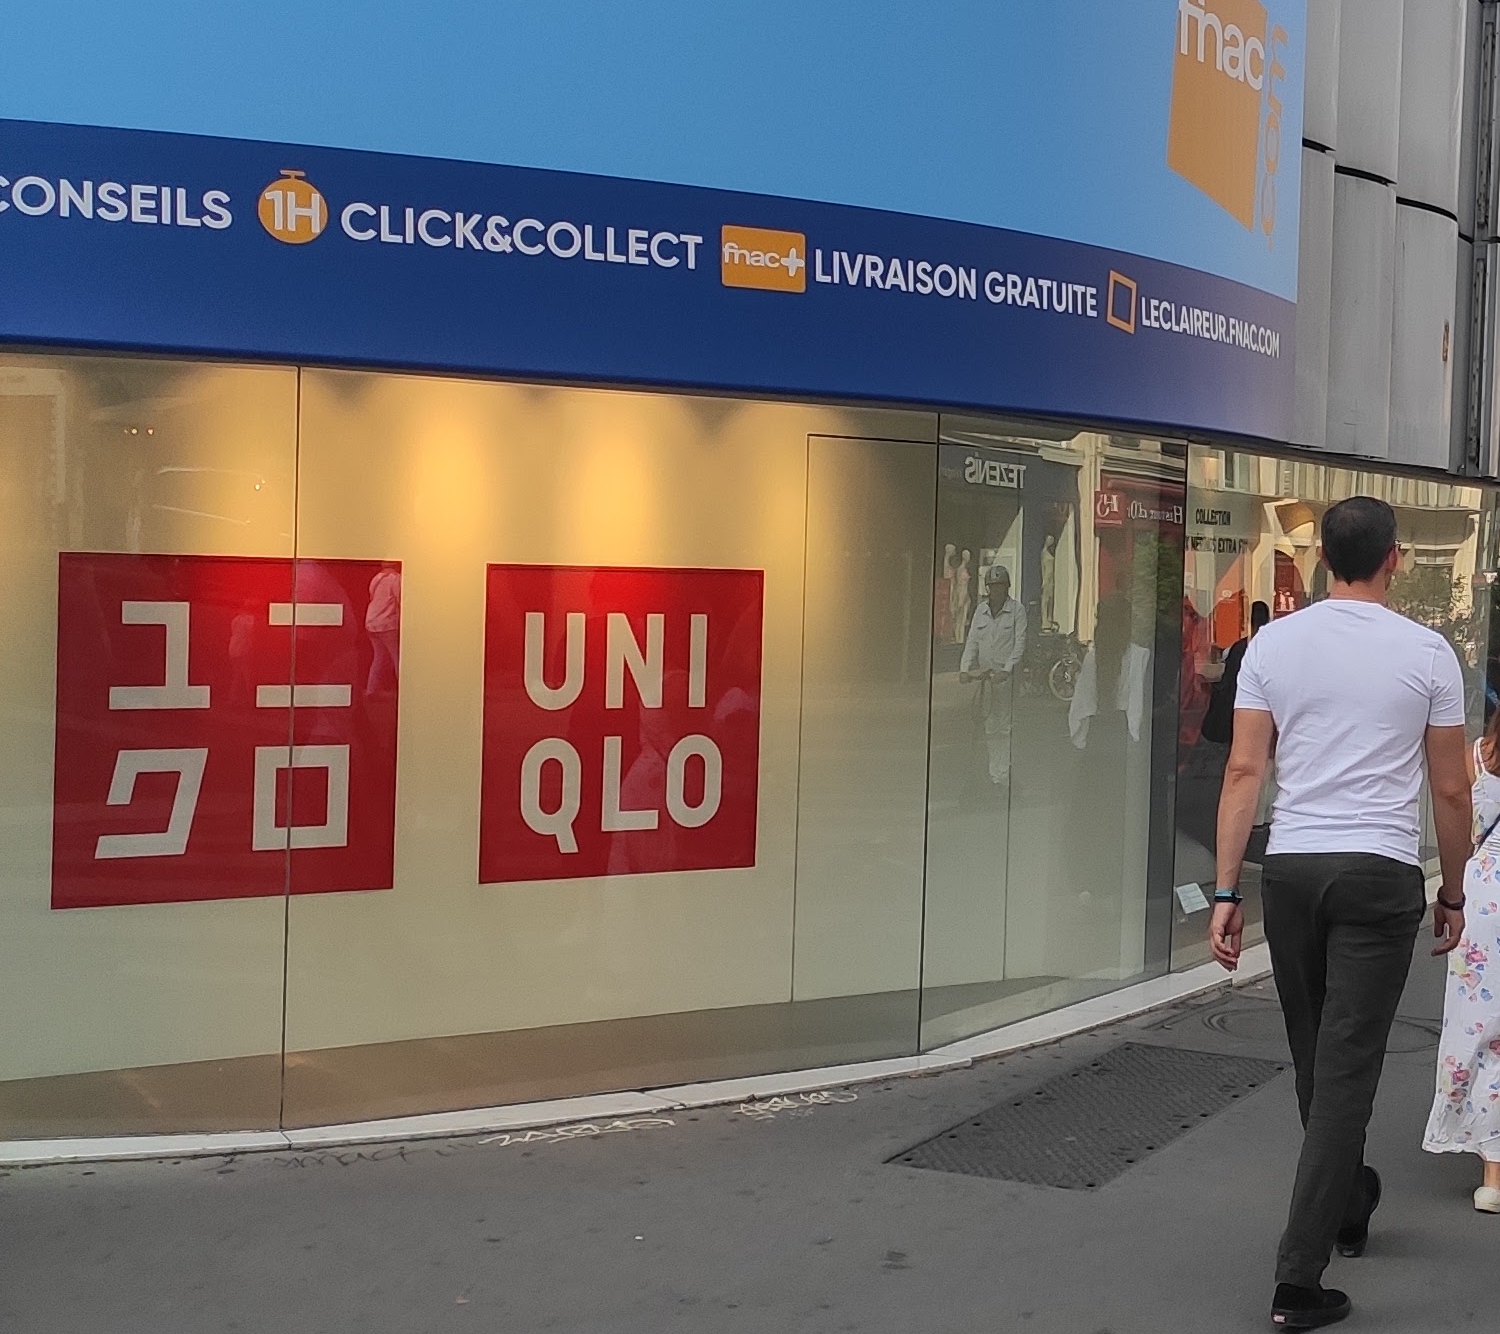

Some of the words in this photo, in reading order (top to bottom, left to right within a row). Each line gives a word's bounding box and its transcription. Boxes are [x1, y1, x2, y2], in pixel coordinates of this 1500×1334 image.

[0, 174, 232, 231] ONSEILS
[340, 202, 703, 271] CLICK&COLLECT
[815, 248, 977, 300] LIVRAISON
[984, 271, 1098, 318] GRATUITE
[1141, 297, 1280, 358] LECLAIREUR.FNAC.COM
[1195, 509, 1231, 525] COLLECTION
[1218, 537, 1237, 554] EXTRA
[109, 601, 351, 711] ユニ
[524, 612, 708, 711] UNI
[94, 744, 350, 860] クロ
[520, 734, 723, 855] QLO
